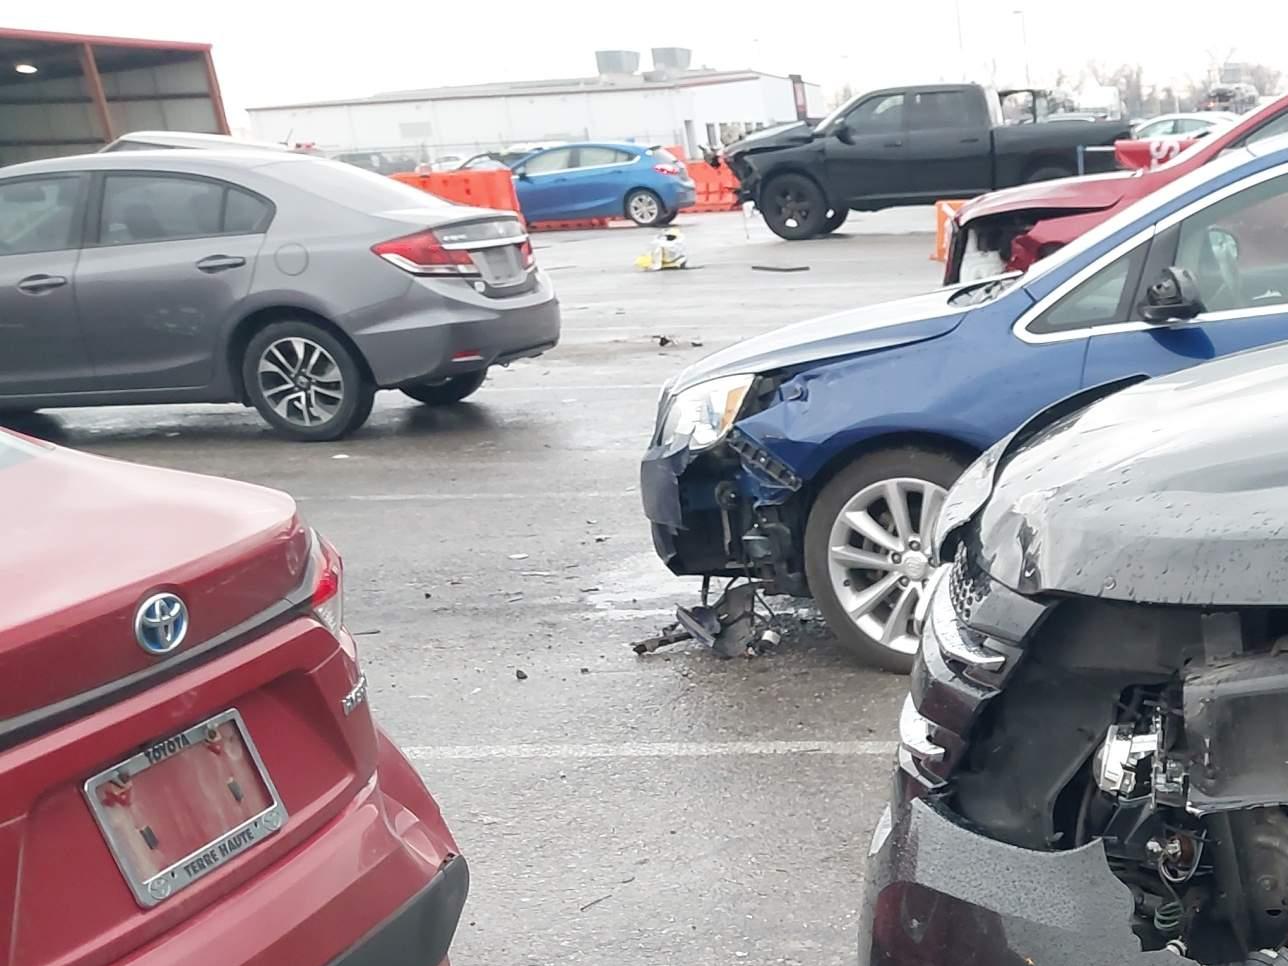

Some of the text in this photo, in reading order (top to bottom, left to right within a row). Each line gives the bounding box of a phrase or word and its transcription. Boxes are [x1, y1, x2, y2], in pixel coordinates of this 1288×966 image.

[145, 736, 190, 765] TOYOTA
[183, 828, 255, 879] TERRE HAUTE
